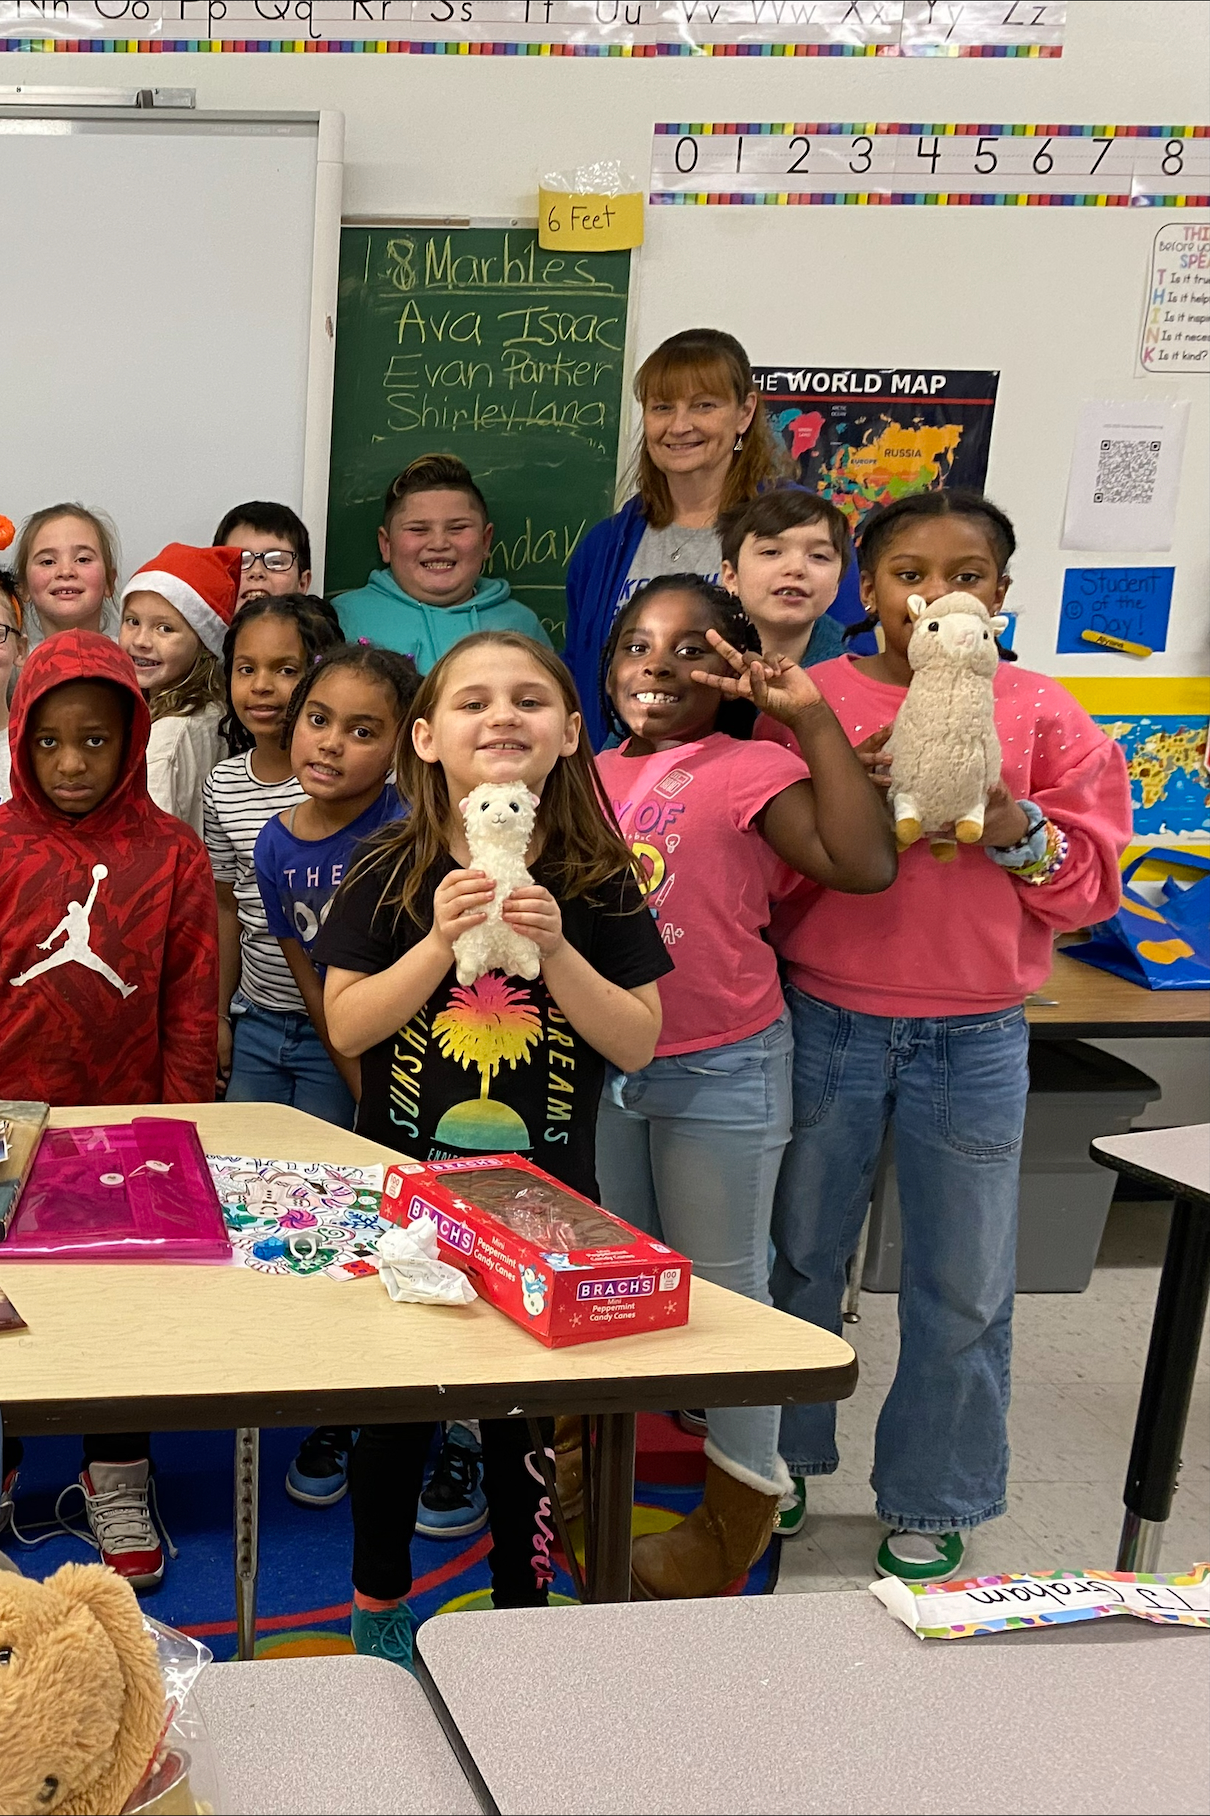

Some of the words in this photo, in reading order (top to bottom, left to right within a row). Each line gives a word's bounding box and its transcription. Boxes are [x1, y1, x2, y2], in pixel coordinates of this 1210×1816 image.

[674, 136, 698, 173] 0
[736, 136, 743, 173] 1
[787, 136, 809, 174] 2
[849, 136, 873, 174] 3
[917, 137, 941, 174] 4
[975, 138, 999, 175] 5
[1032, 138, 1055, 175] 6
[1090, 138, 1114, 175] 7
[1161, 139, 1184, 176] 8
[548, 205, 561, 232] 6
[570, 204, 616, 231] Feet
[425, 232, 596, 289] Marbles
[1157, 269, 1166, 285] T
[1153, 288, 1165, 305] H
[393, 299, 482, 346] Ava
[497, 306, 622, 351] Isaac
[1146, 327, 1160, 343] N
[1143, 347, 1156, 363] K
[382, 354, 492, 389] Evan
[501, 348, 613, 390] Parker
[753, 373, 778, 391] HE
[787, 372, 882, 394] WORLD
[890, 374, 947, 395] MAP
[884, 448, 922, 458] RUSSIA
[480, 516, 587, 576] nday
[1080, 569, 1161, 596] Student
[1091, 594, 1108, 612] of
[1117, 593, 1147, 611] the
[634, 799, 685, 835] OF
[283, 864, 344, 888] THE
[390, 1004, 429, 1138] SUNSH
[543, 1006, 575, 1145] DREAMS
[477, 1237, 517, 1269] Peppermint
[491, 1236, 506, 1250] Mini
[474, 1249, 494, 1270] Candy
[495, 1261, 516, 1282] Canes
[663, 1271, 677, 1279] 100
[581, 1280, 651, 1297] BRACHS
[590, 1313, 613, 1322] Candy
[614, 1311, 636, 1320] Canes
[592, 1302, 635, 1313] Peppermint
[966, 1580, 1125, 1606] Graham
